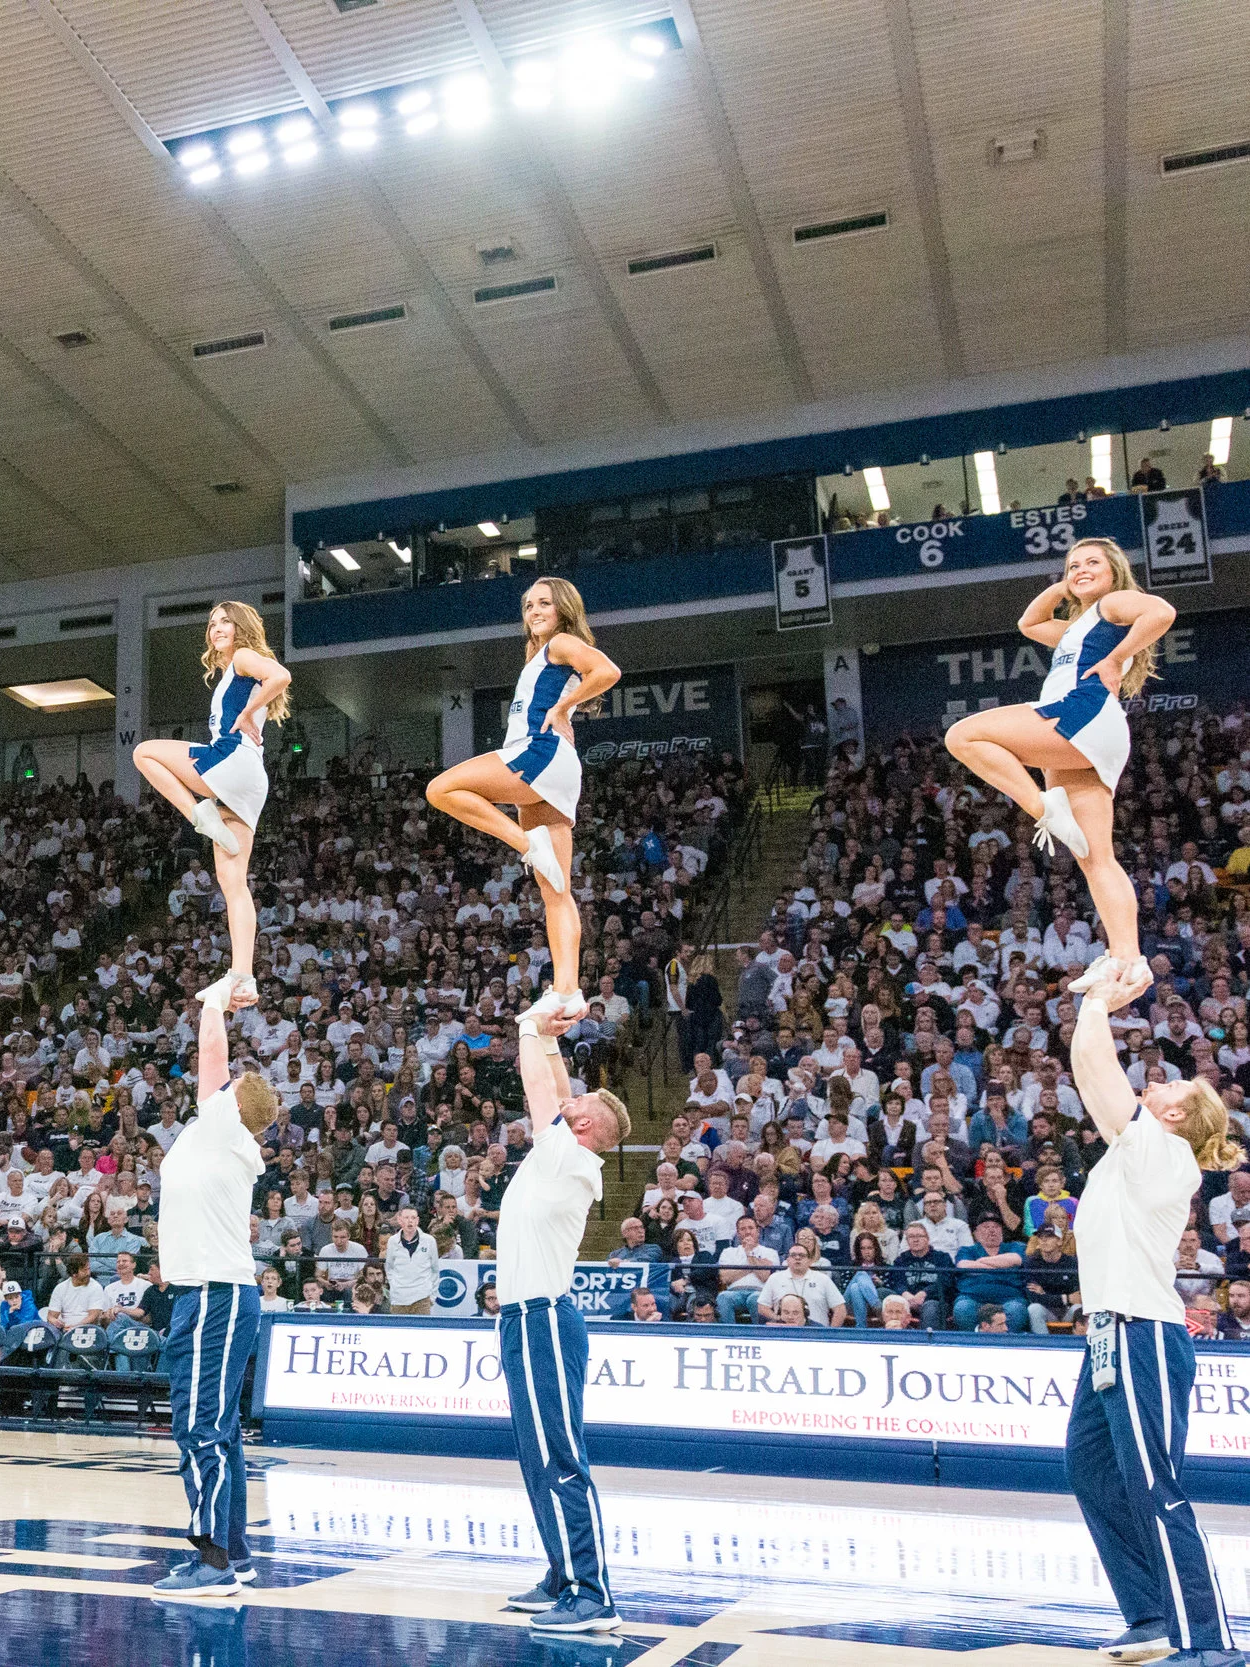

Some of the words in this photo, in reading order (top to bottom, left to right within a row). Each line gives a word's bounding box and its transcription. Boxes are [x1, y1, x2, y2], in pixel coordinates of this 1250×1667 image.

[1010, 503, 1088, 528] ESTES
[896, 520, 964, 544] COOK
[1024, 523, 1076, 554] 33
[919, 540, 944, 567] 6
[1155, 533, 1196, 557] 24
[794, 579, 810, 598] 5
[834, 655, 850, 671] A
[938, 646, 1054, 685] THA
[1164, 628, 1197, 663] E
[1148, 694, 1199, 713] Pro
[119, 730, 136, 746] W
[570, 1272, 637, 1291] ORTS
[331, 1332, 362, 1345] THE
[283, 1335, 448, 1379] HERALD
[725, 1345, 762, 1360] THE
[673, 1347, 867, 1397] HERALD
[881, 1354, 1078, 1409] JOURNA
[1197, 1363, 1237, 1378] THE
[331, 1391, 437, 1409] EMPOWERING
[443, 1396, 473, 1410] THE
[732, 1409, 858, 1430] EMPOWERING
[863, 1416, 901, 1432] THE
[906, 1418, 1031, 1439] COMMUNITY
